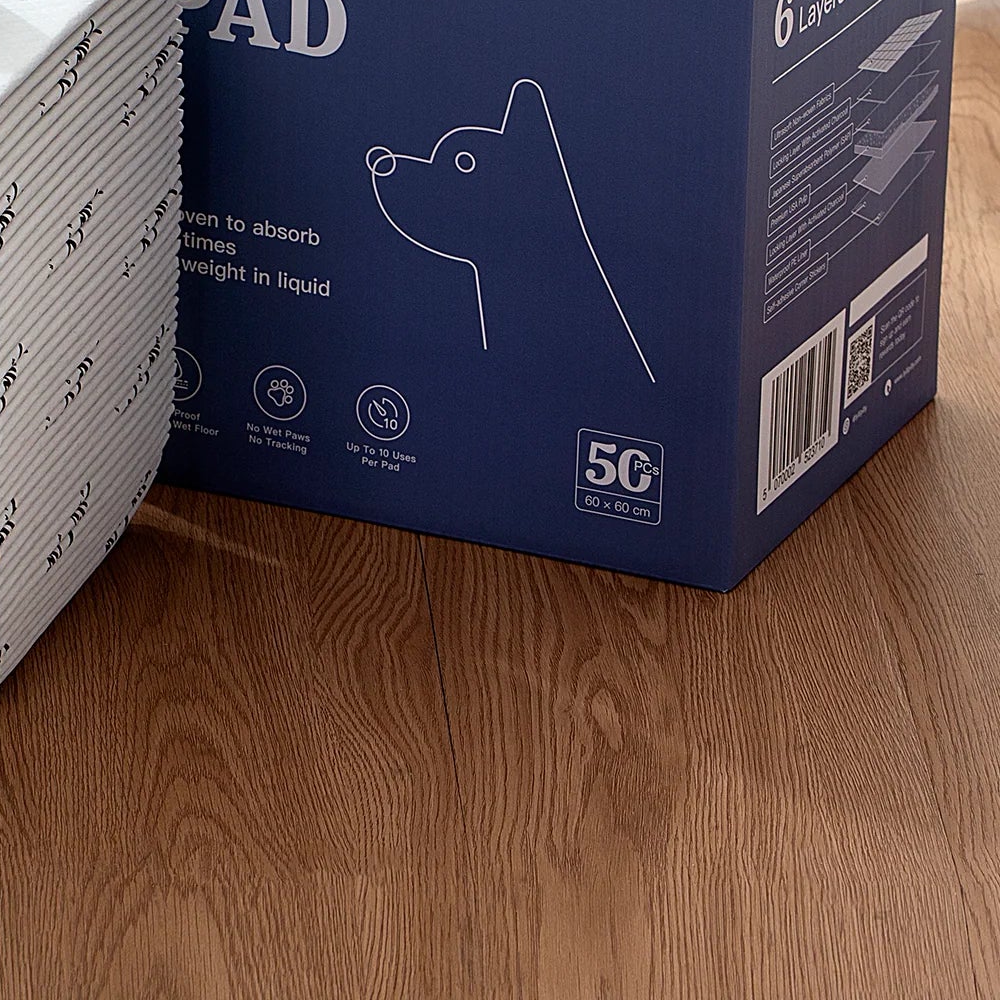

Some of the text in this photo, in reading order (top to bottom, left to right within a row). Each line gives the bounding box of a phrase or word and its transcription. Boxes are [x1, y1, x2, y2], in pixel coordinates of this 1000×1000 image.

[226, 215, 245, 232] to
[253, 220, 320, 246] absorb
[183, 232, 236, 255] times
[181, 258, 330, 297] weight in liquid
[174, 410, 200, 421] Proof
[383, 418, 398, 430] 10
[173, 420, 219, 437] Wet Floor
[247, 422, 311, 443] No Wet Paws
[249, 435, 307, 456] No Tracking
[347, 442, 416, 464] Up To 10 Uses
[361, 456, 400, 472] Per Pad
[634, 460, 660, 476] PCs
[762, 488, 768, 501] 5
[584, 495, 600, 507] 60
[614, 500, 630, 513] 60
[632, 506, 651, 517] cm
